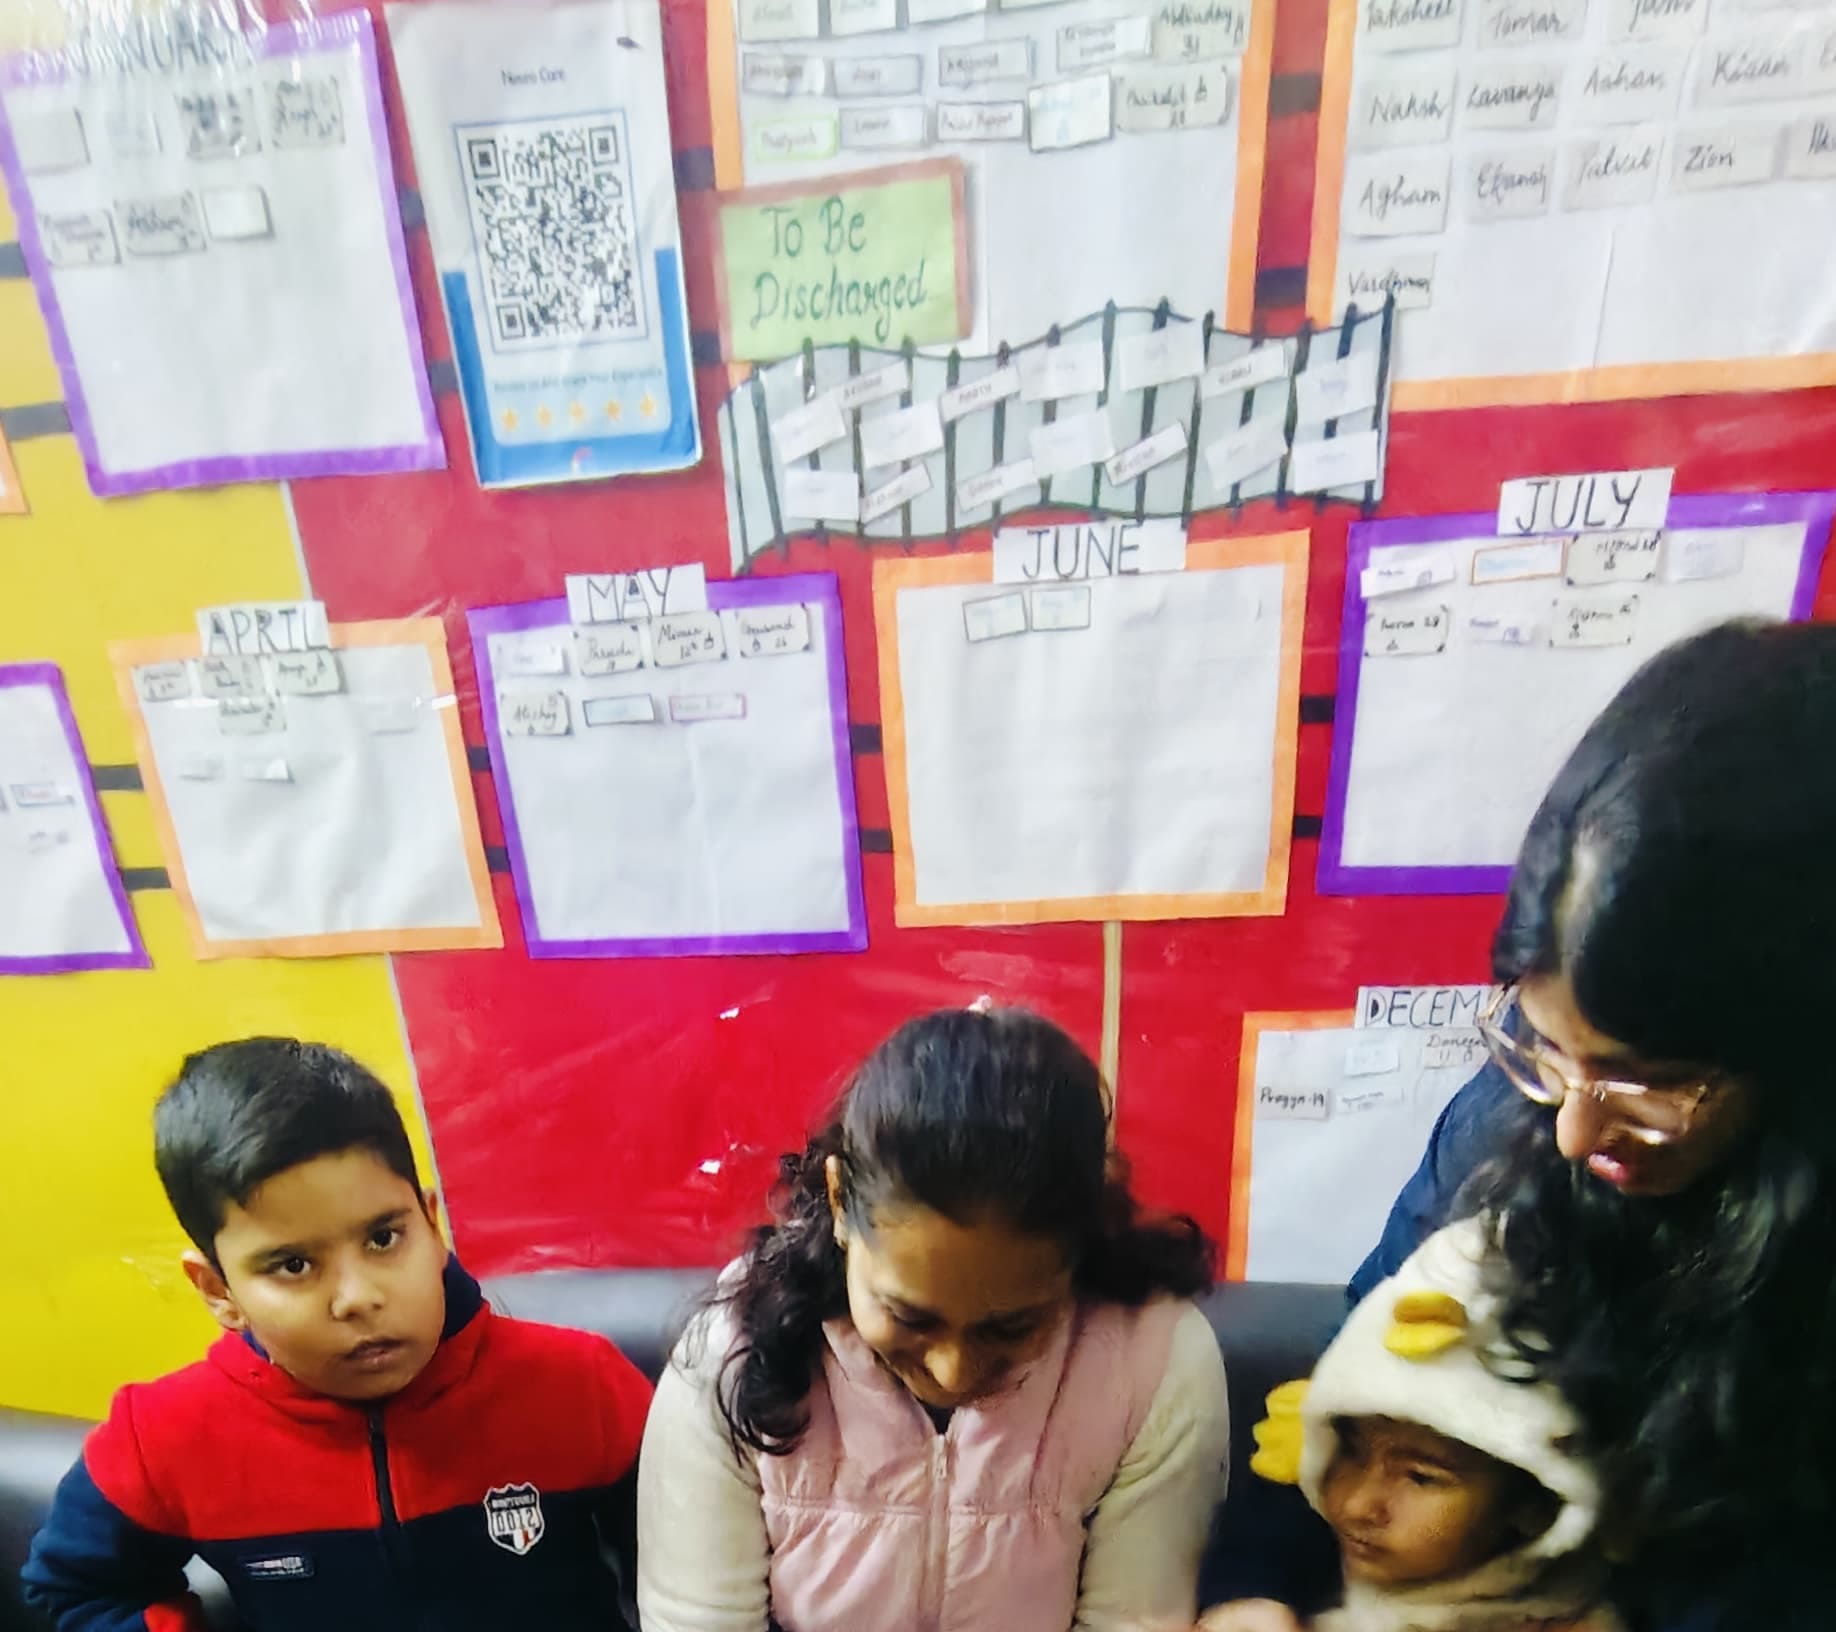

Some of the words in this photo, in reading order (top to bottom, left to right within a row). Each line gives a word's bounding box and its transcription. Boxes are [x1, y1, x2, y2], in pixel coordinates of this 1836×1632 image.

[760, 205, 803, 257] To
[819, 194, 867, 254] Be
[751, 256, 928, 343] Discharged
[1515, 474, 1643, 532] JULY
[1022, 524, 1140, 579] JUNE
[587, 567, 673, 624] MAY
[208, 608, 332, 656] APRIL
[1364, 989, 1484, 1029] DECEM
